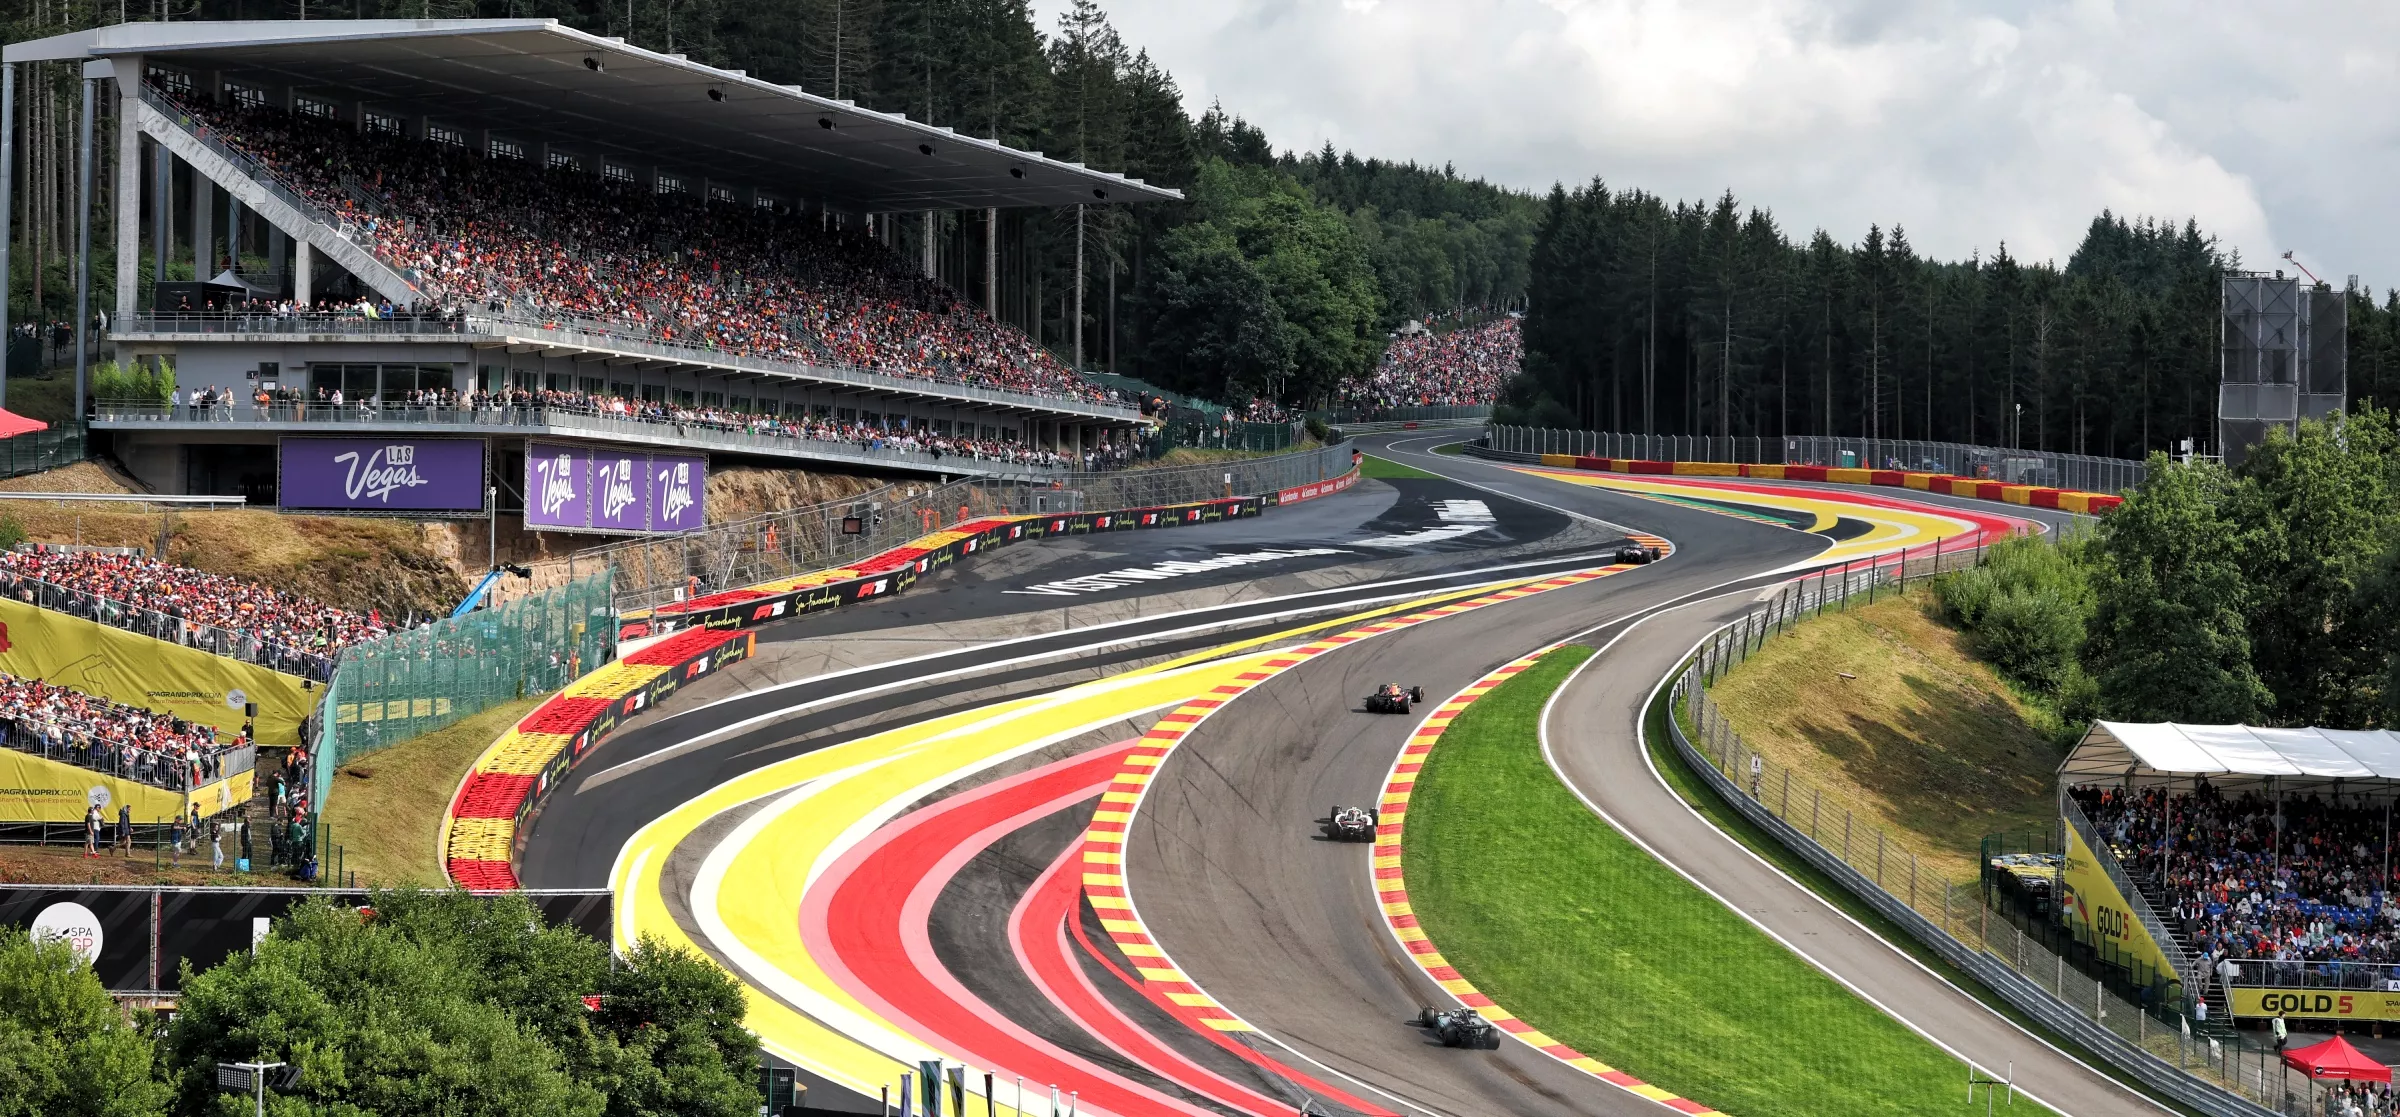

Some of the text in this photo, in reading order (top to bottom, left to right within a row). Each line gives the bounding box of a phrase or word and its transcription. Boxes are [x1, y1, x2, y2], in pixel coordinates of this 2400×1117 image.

[388, 446, 412, 463] LAS
[334, 449, 428, 503] Vegas
[538, 458, 575, 519] Vegas
[600, 462, 636, 522] Vegas
[659, 466, 693, 525] Vegas
[71, 927, 92, 936] SPA
[2098, 906, 2129, 940] GOLD 5
[70, 938, 93, 952] GP
[2261, 994, 2353, 1014] GOLD 5
